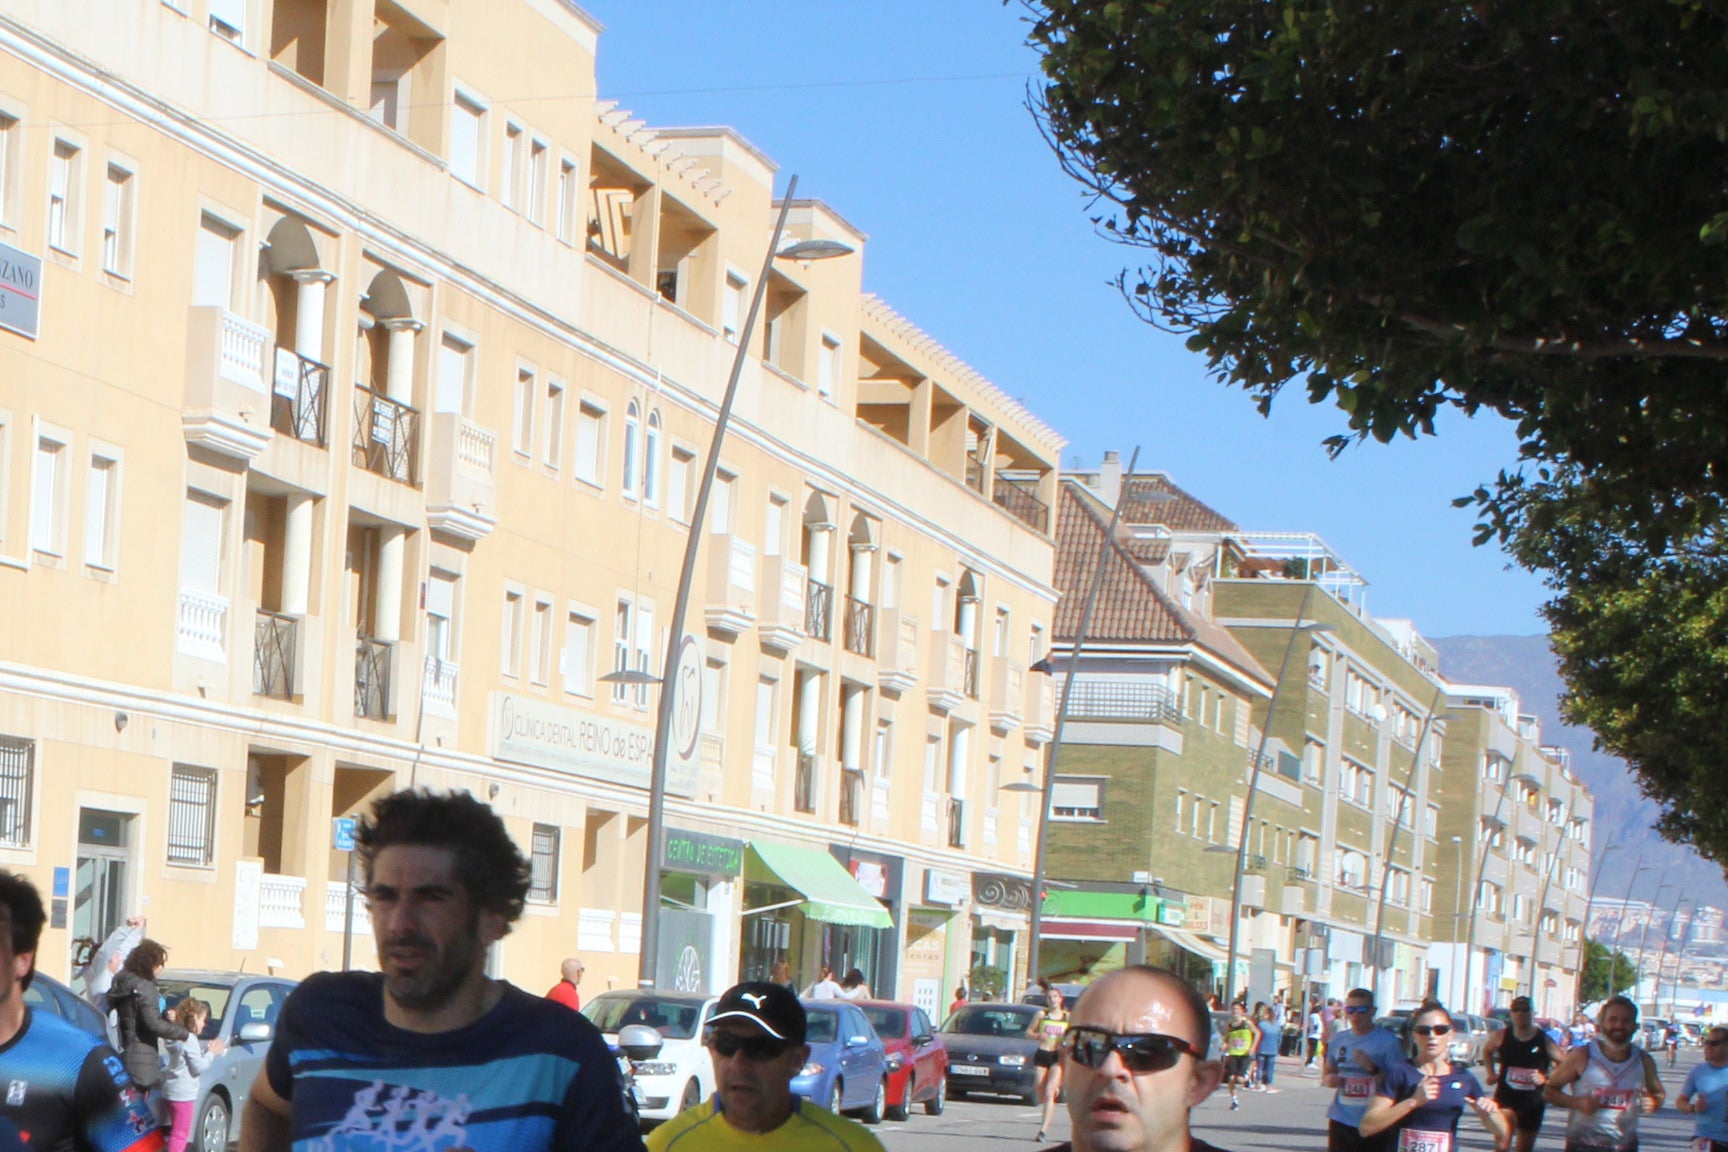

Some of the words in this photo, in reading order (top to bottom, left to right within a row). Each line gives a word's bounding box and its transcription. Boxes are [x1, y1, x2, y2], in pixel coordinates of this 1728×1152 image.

[547, 721, 576, 749] DENTAL
[580, 720, 610, 755] REINO
[613, 729, 626, 760] de
[628, 732, 652, 765] ESPA
